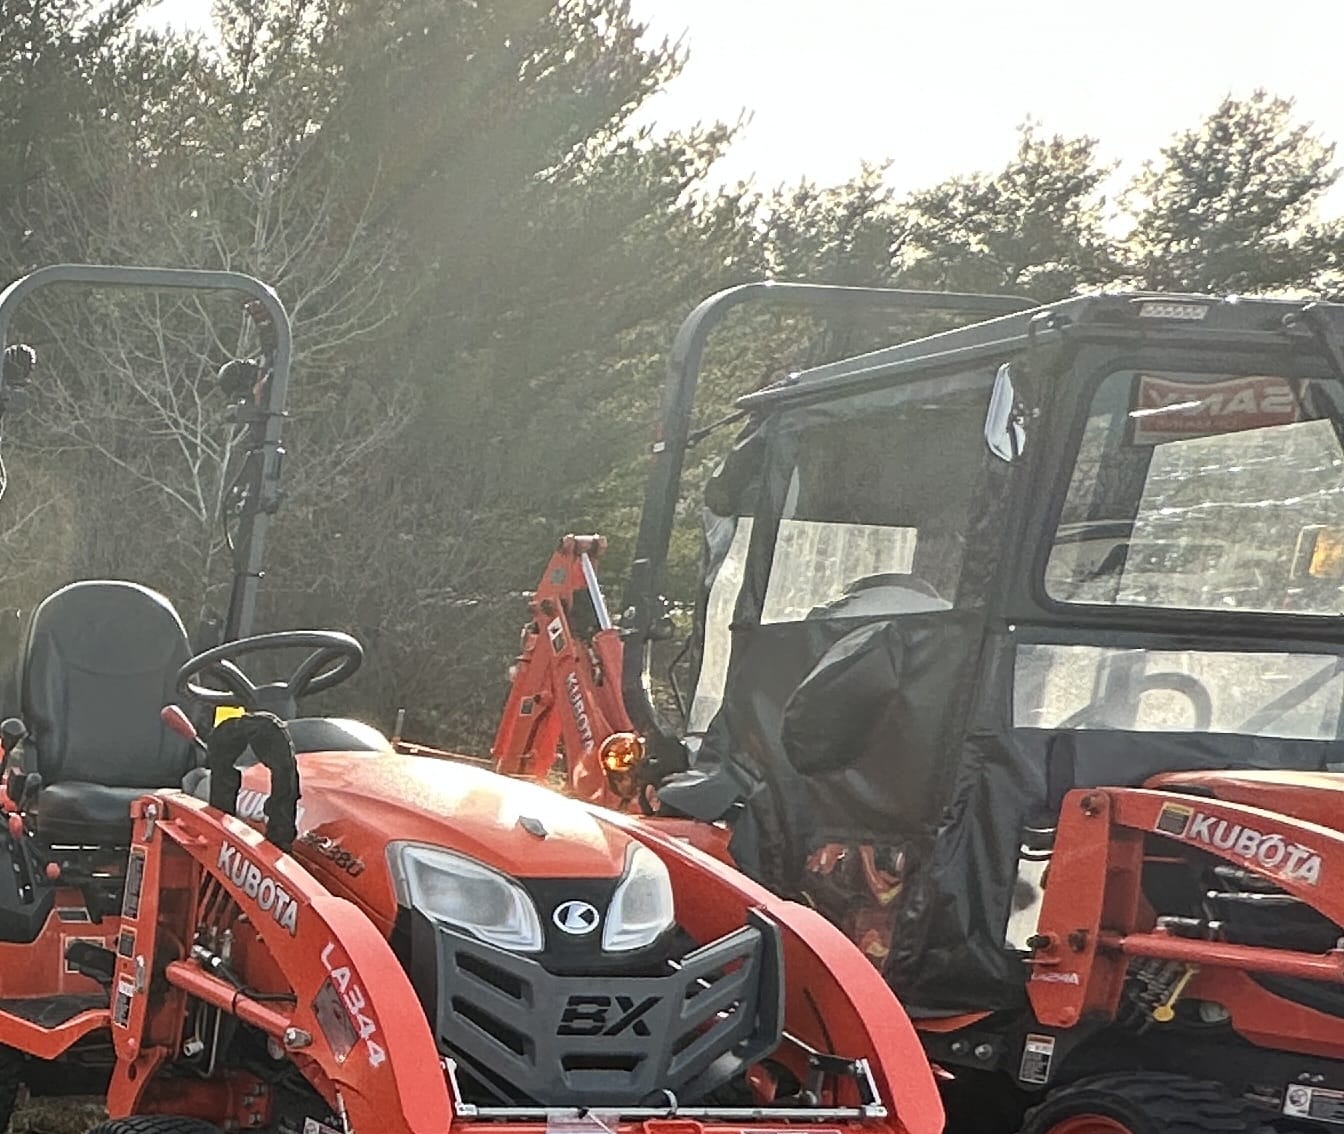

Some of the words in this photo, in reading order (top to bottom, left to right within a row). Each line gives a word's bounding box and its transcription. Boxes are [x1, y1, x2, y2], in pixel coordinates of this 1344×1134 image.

[566, 671, 594, 755] KUBOTA
[216, 840, 299, 937] KUBOTA
[1189, 813, 1322, 886] KUBOTA
[320, 941, 386, 1068] LA344
[555, 994, 665, 1037] BX
